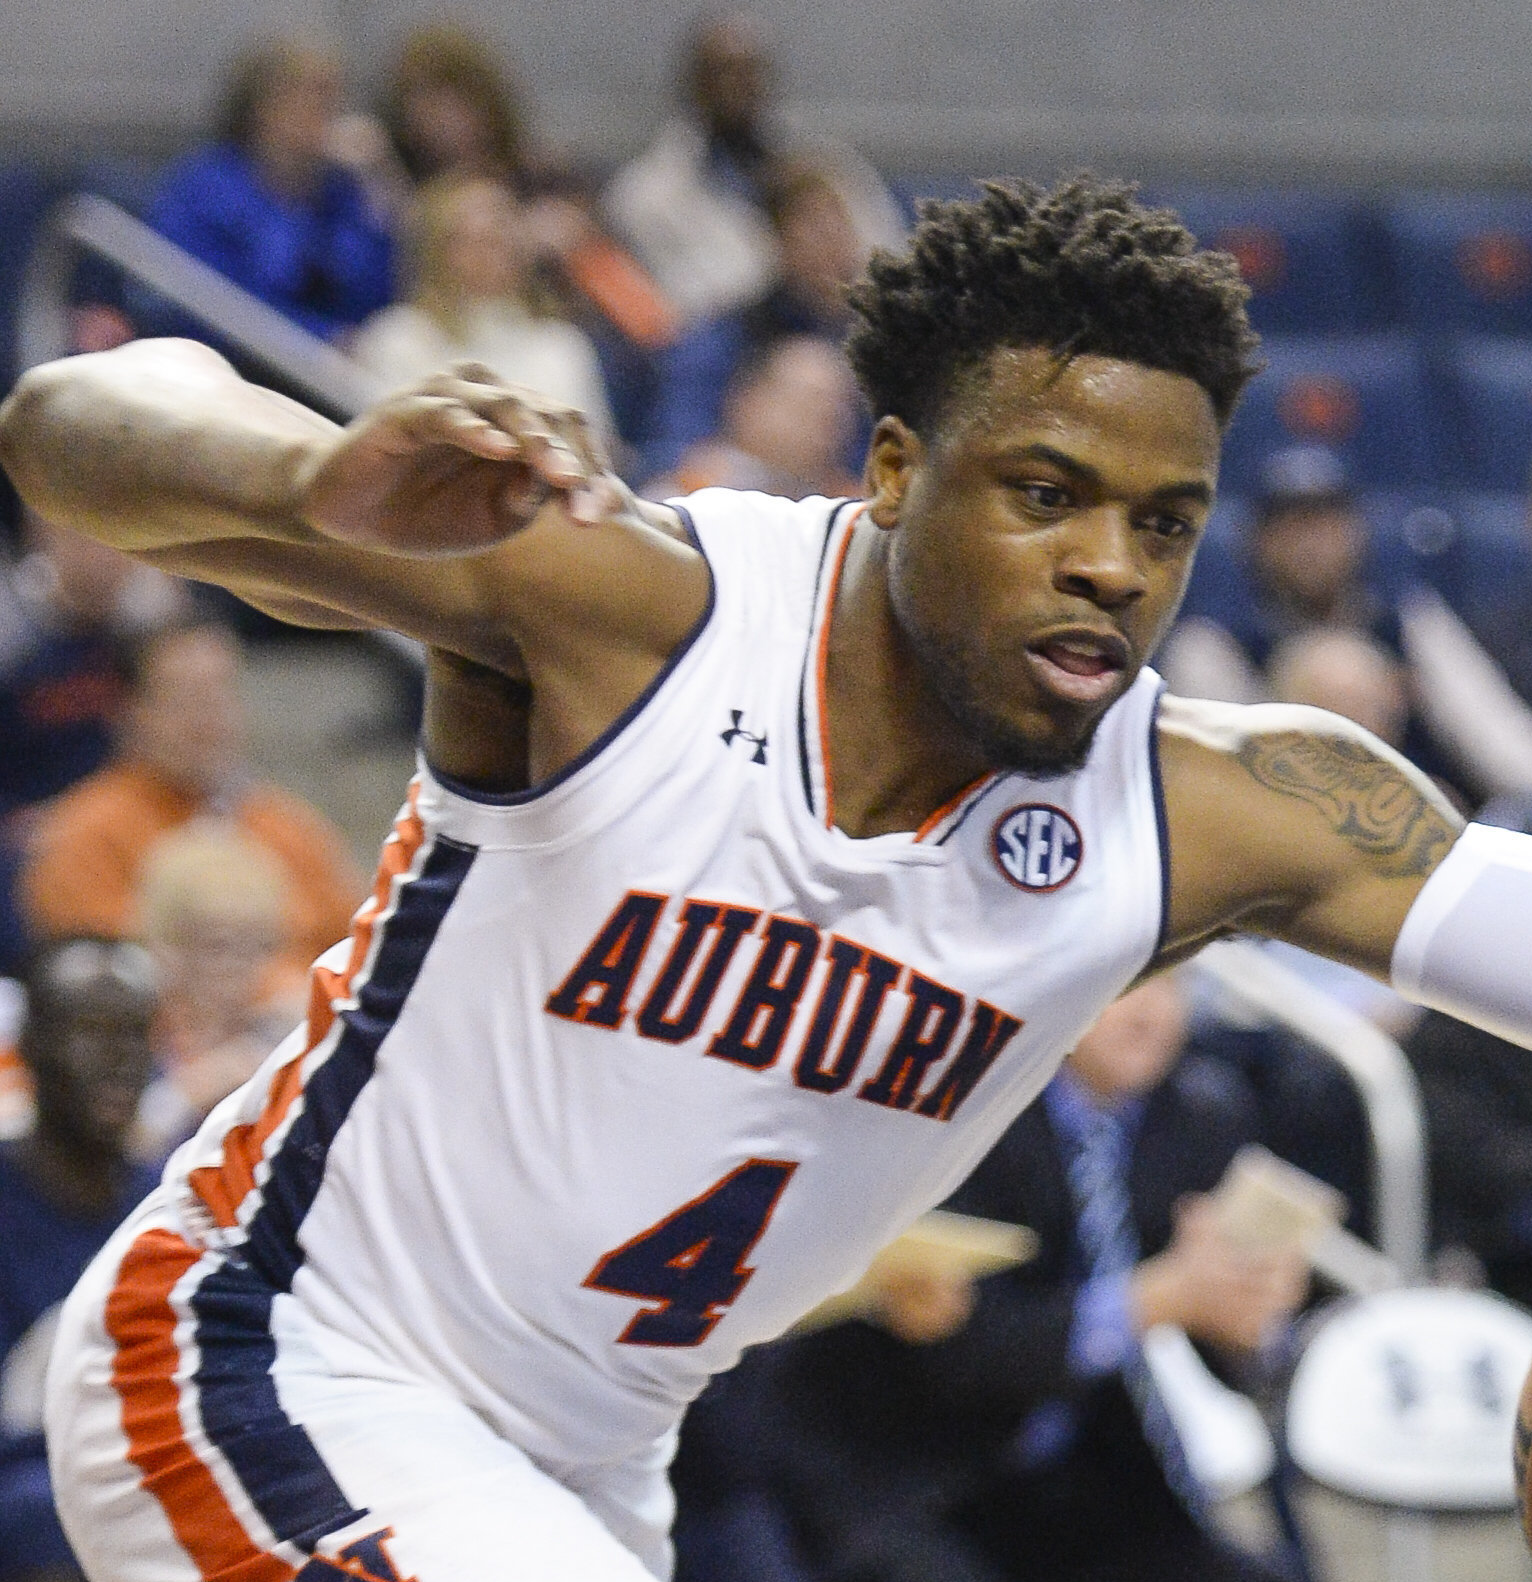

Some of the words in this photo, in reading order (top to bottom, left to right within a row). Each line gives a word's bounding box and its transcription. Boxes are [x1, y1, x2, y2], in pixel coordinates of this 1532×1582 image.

[998, 808, 1080, 888] SEC
[545, 889, 1025, 1122] AUBURN
[582, 1157, 800, 1348] 4
